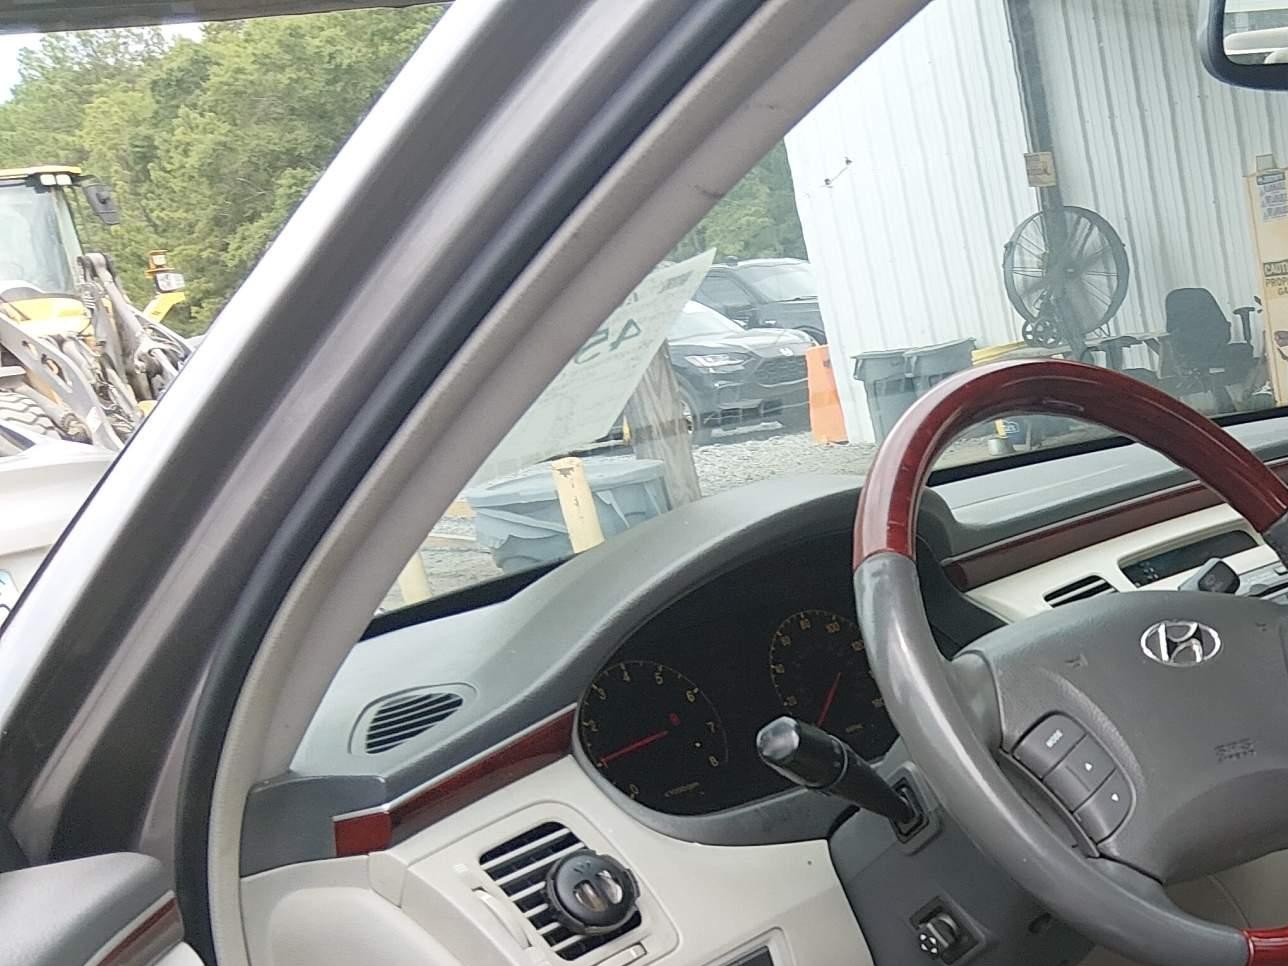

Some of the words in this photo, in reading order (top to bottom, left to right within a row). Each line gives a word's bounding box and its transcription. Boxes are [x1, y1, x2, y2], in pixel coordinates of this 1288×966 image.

[622, 670, 632, 682] 4
[685, 690, 696, 703] 6
[709, 755, 719, 767] 8
